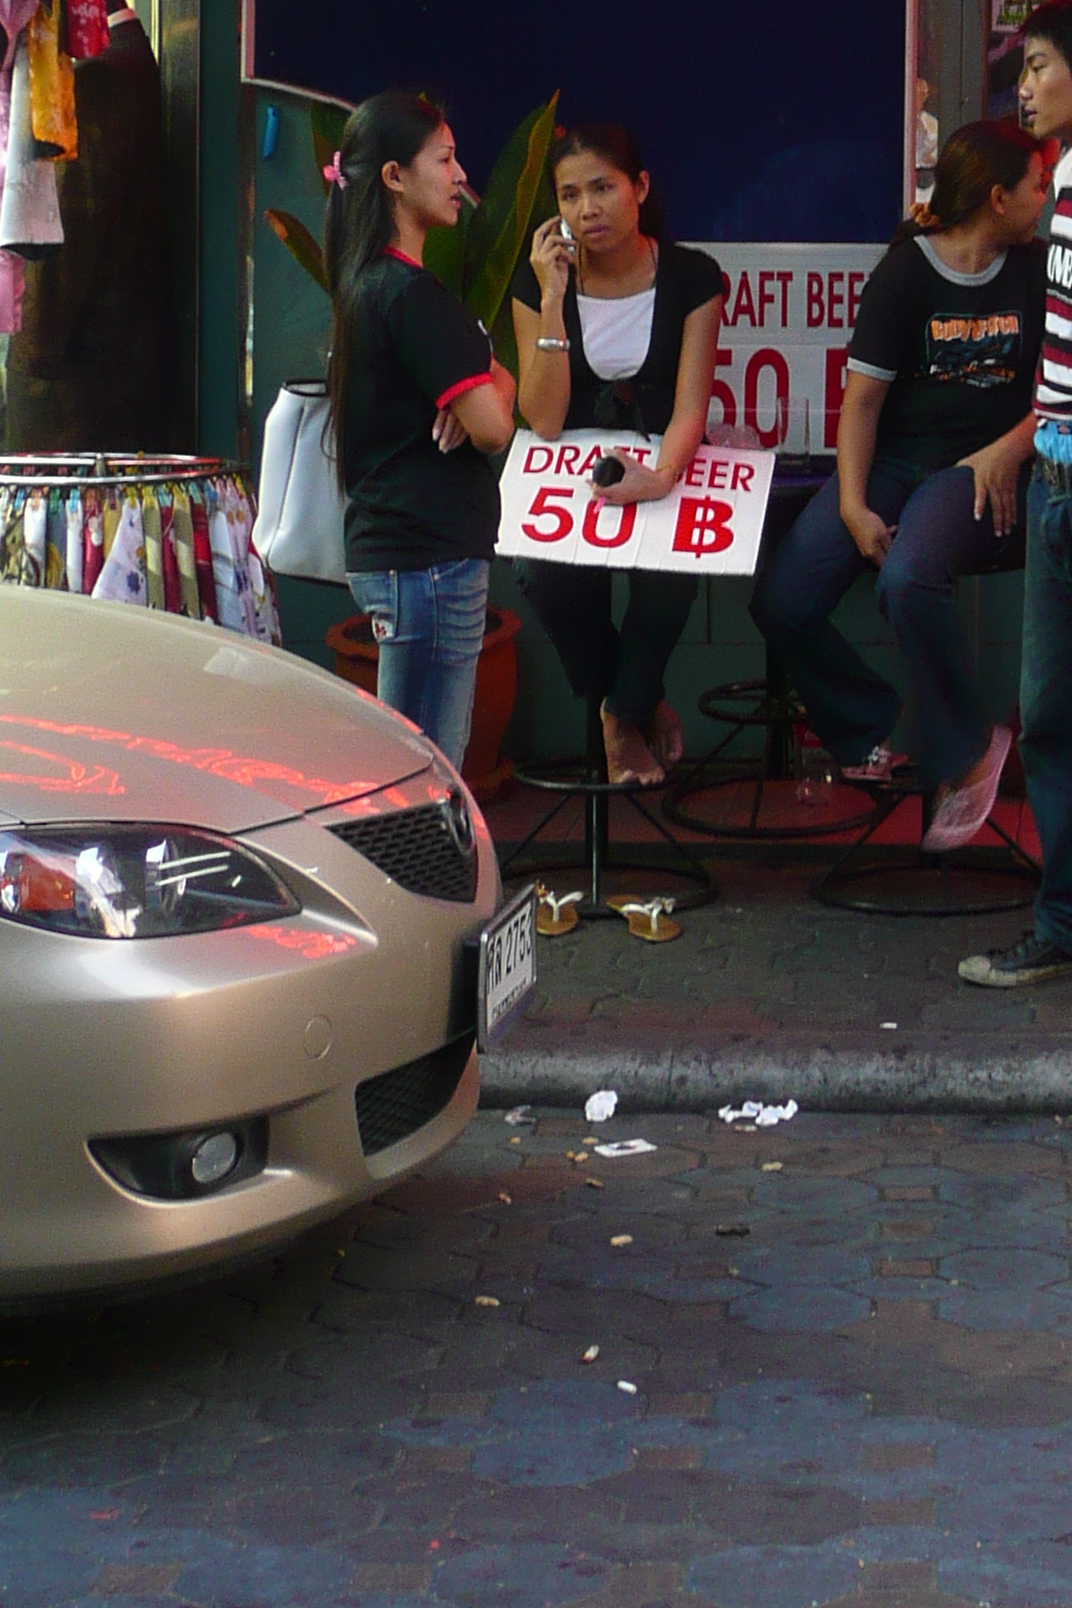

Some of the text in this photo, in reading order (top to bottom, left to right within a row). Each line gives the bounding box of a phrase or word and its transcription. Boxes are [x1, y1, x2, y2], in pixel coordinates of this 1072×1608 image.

[807, 270, 869, 329] BEE
[522, 445, 756, 492] DRAT EER
[521, 486, 638, 549] 50
